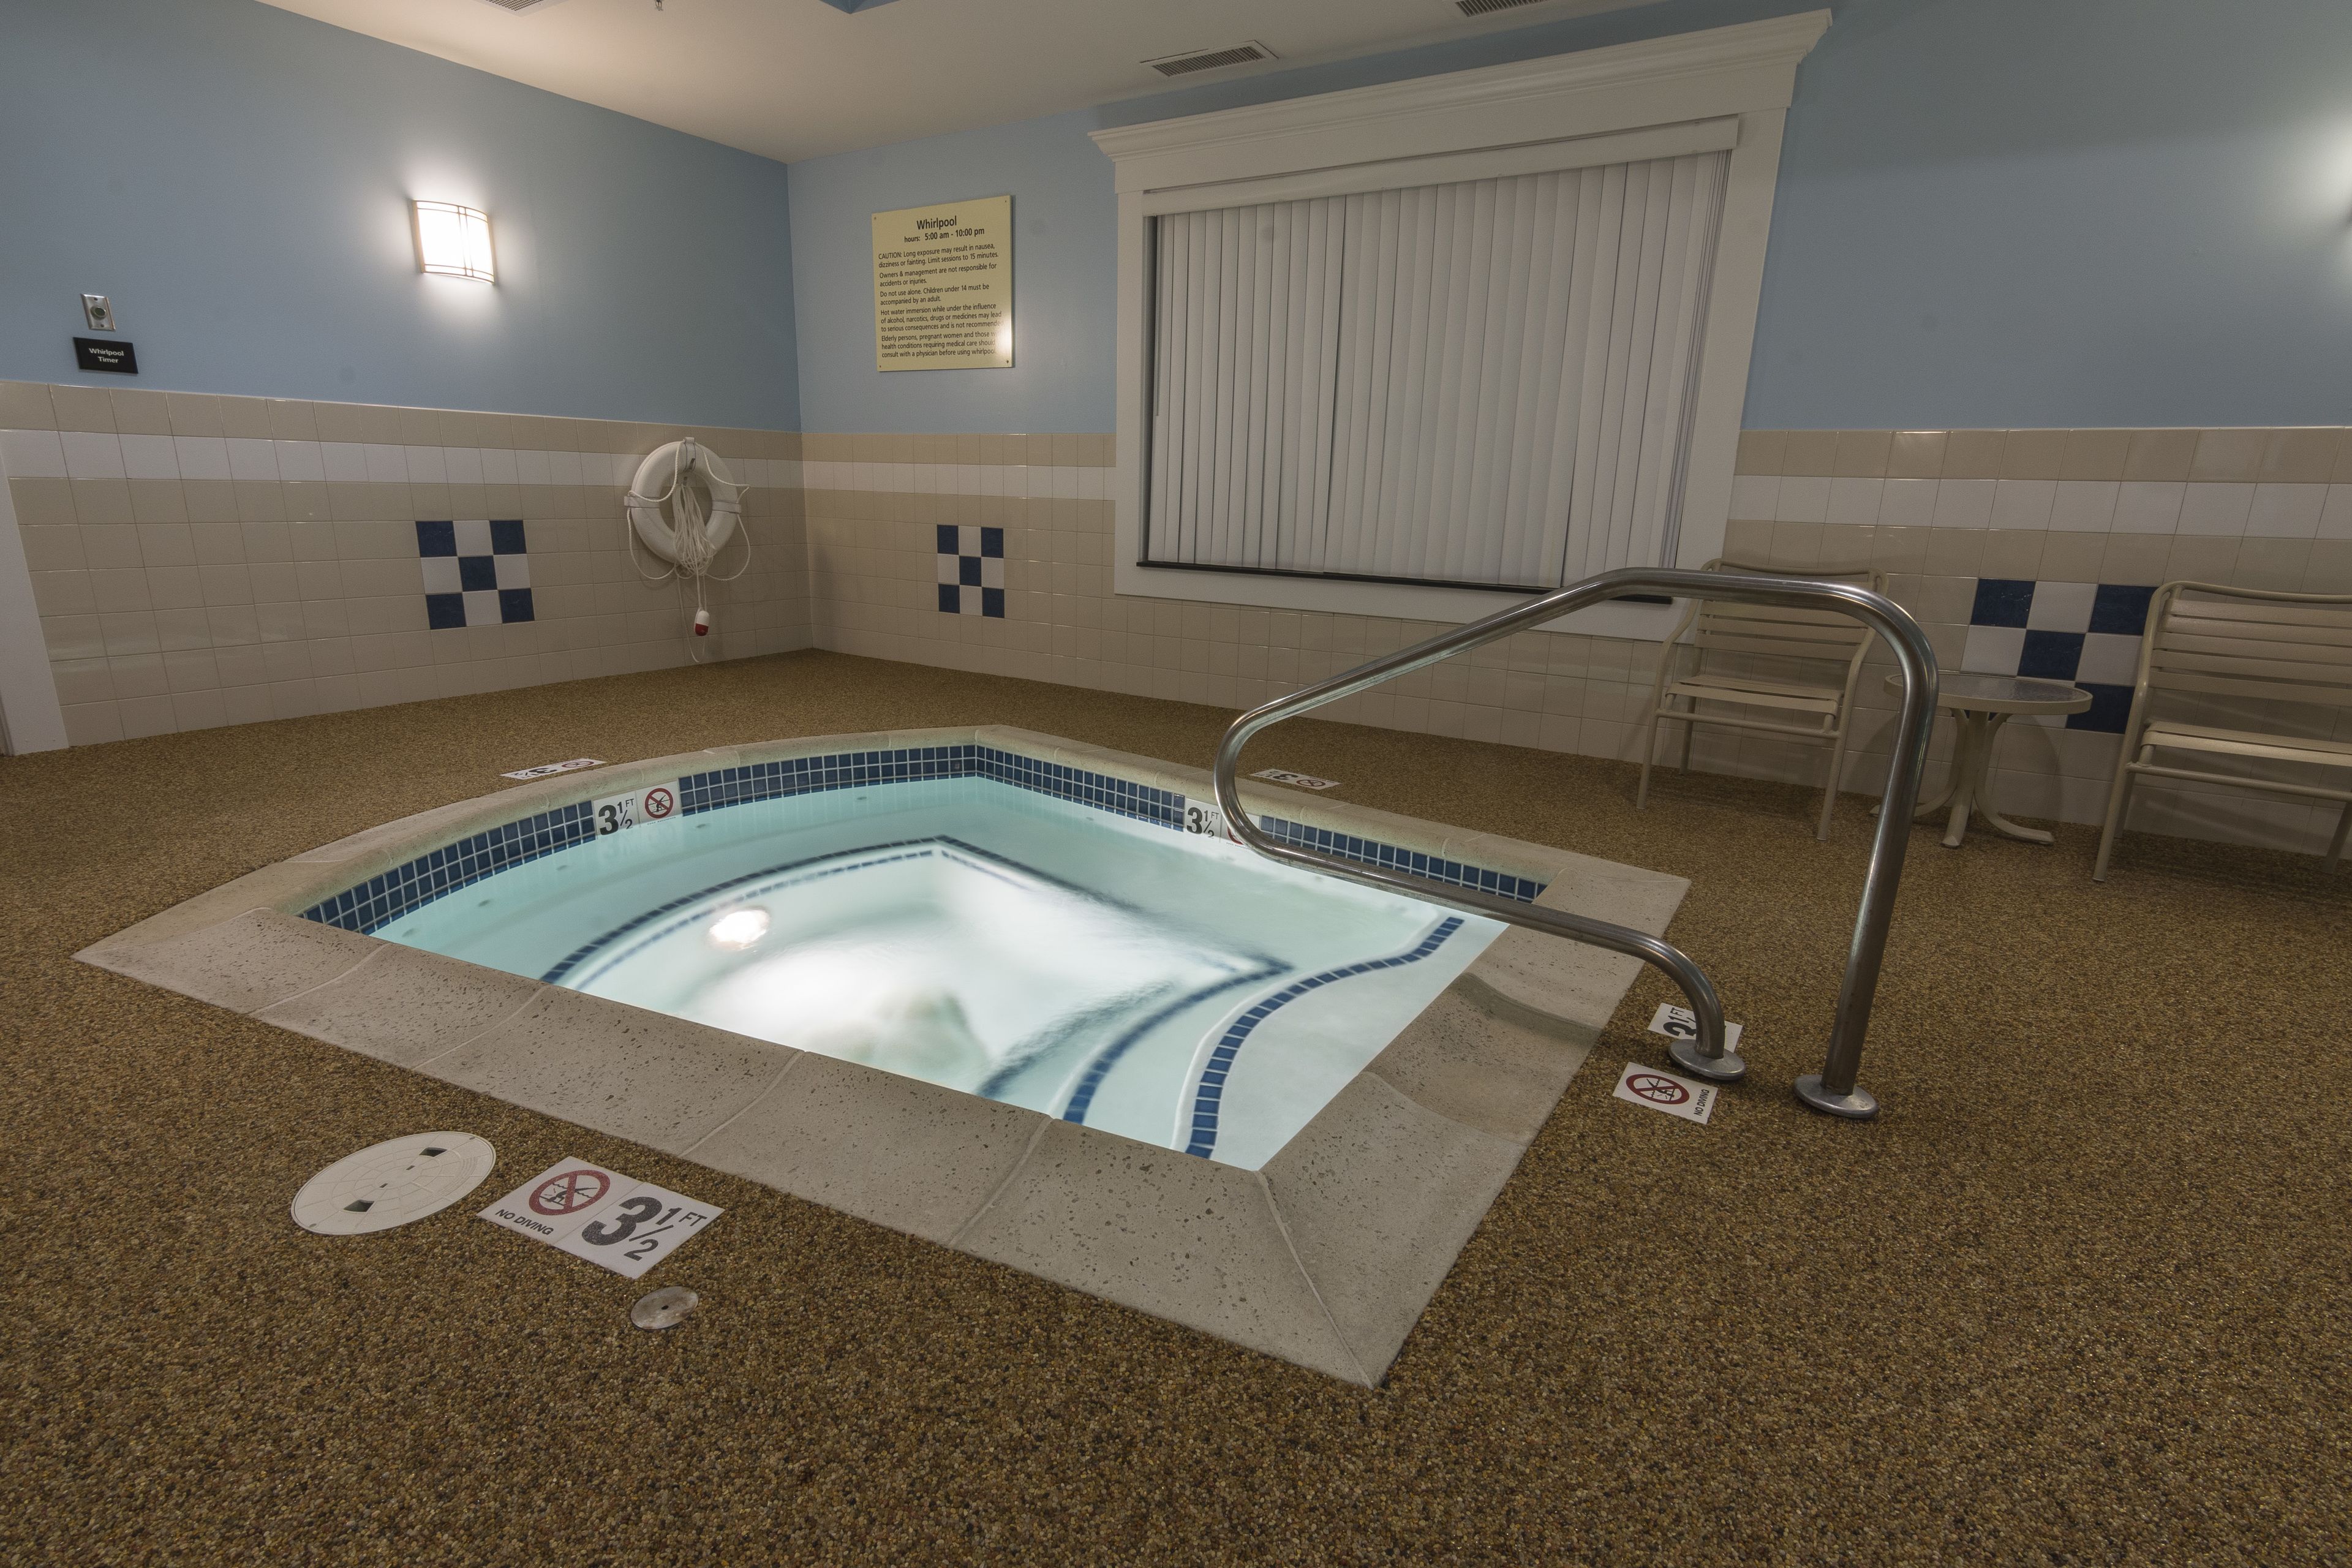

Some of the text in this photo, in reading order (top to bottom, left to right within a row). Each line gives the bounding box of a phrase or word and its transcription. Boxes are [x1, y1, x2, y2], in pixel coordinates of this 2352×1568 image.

[916, 216, 957, 230] Whirlpool
[925, 232, 938, 241] 5:00
[956, 228, 973, 237] 10:00
[974, 228, 985, 237] pm
[905, 268, 938, 277] management
[959, 263, 987, 273] responsible
[880, 297, 911, 306] accompanied
[88, 347, 124, 356] Whirlpool
[923, 341, 945, 349] requiring
[598, 805, 619, 835] 3
[625, 799, 635, 807] FT
[1186, 807, 1203, 834] 3
[1694, 1089, 1710, 1117] NO DIVING
[495, 1208, 554, 1236] NO DIVING
[581, 1196, 663, 1246] 3
[678, 1211, 709, 1227] FT
